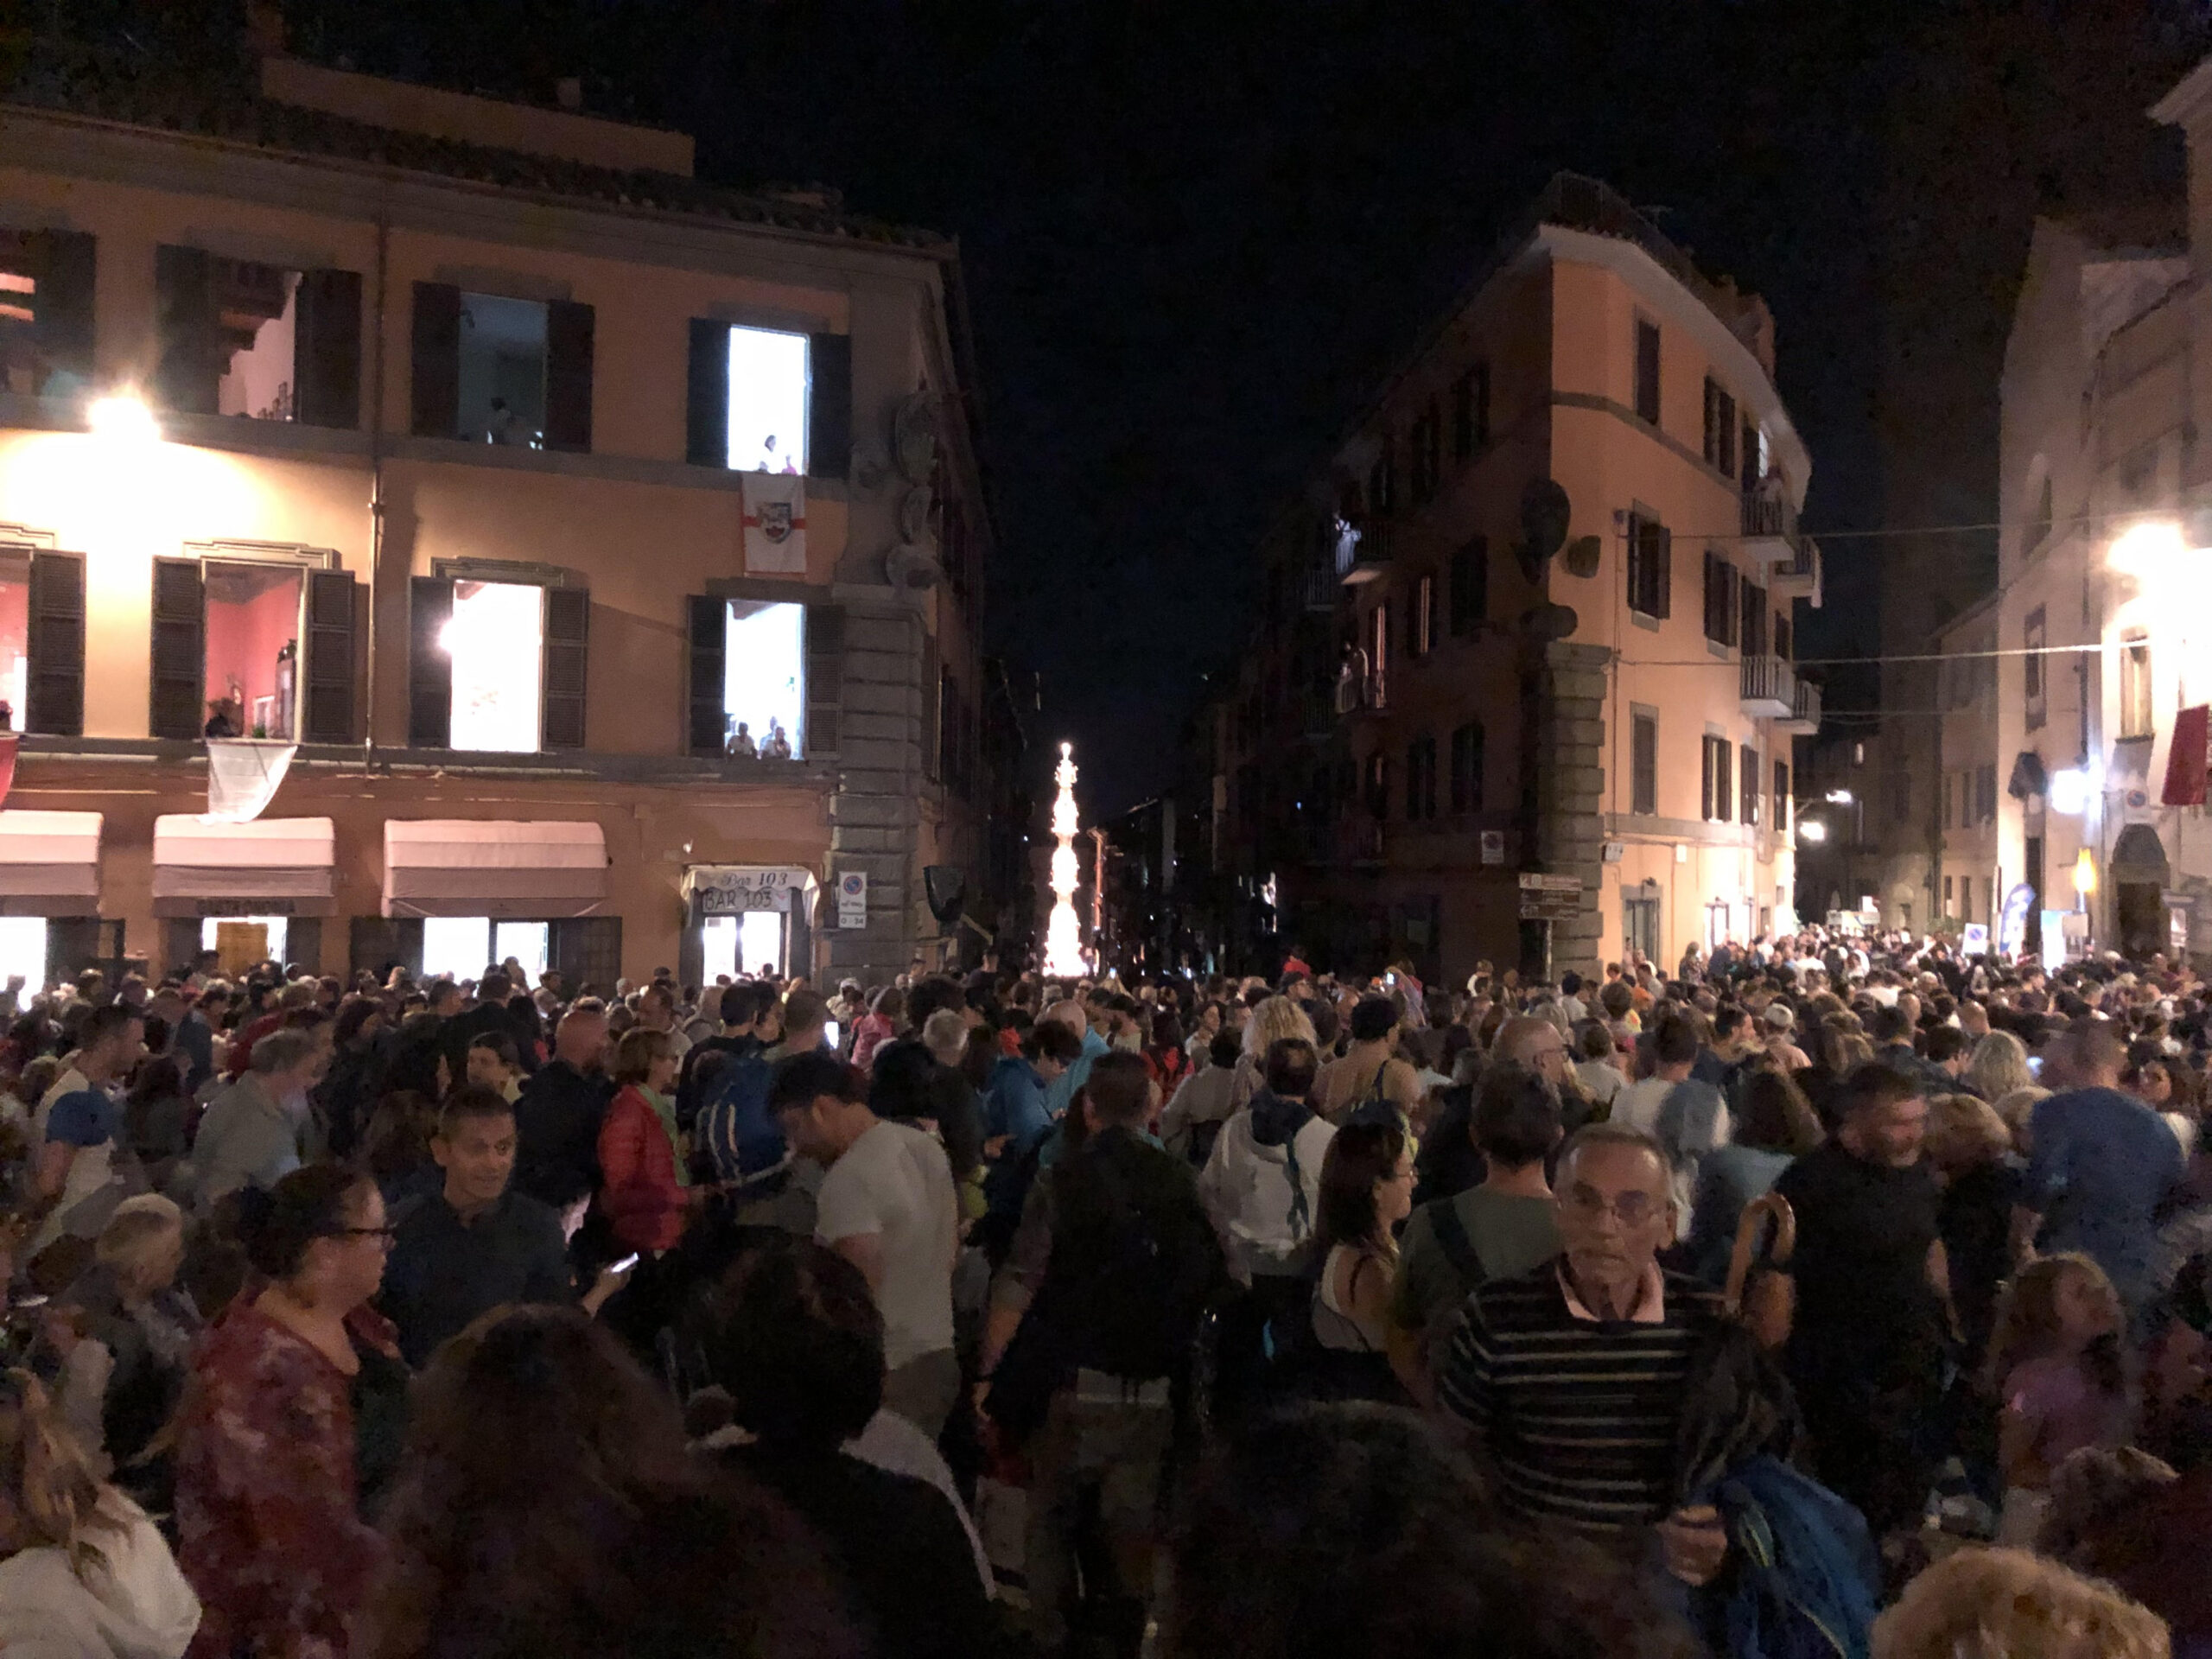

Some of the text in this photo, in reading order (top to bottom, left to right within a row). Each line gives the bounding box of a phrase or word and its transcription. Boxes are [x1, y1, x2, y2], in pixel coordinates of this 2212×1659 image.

[721, 873, 788, 887] Bar 103
[704, 891, 772, 911] BAR 103
